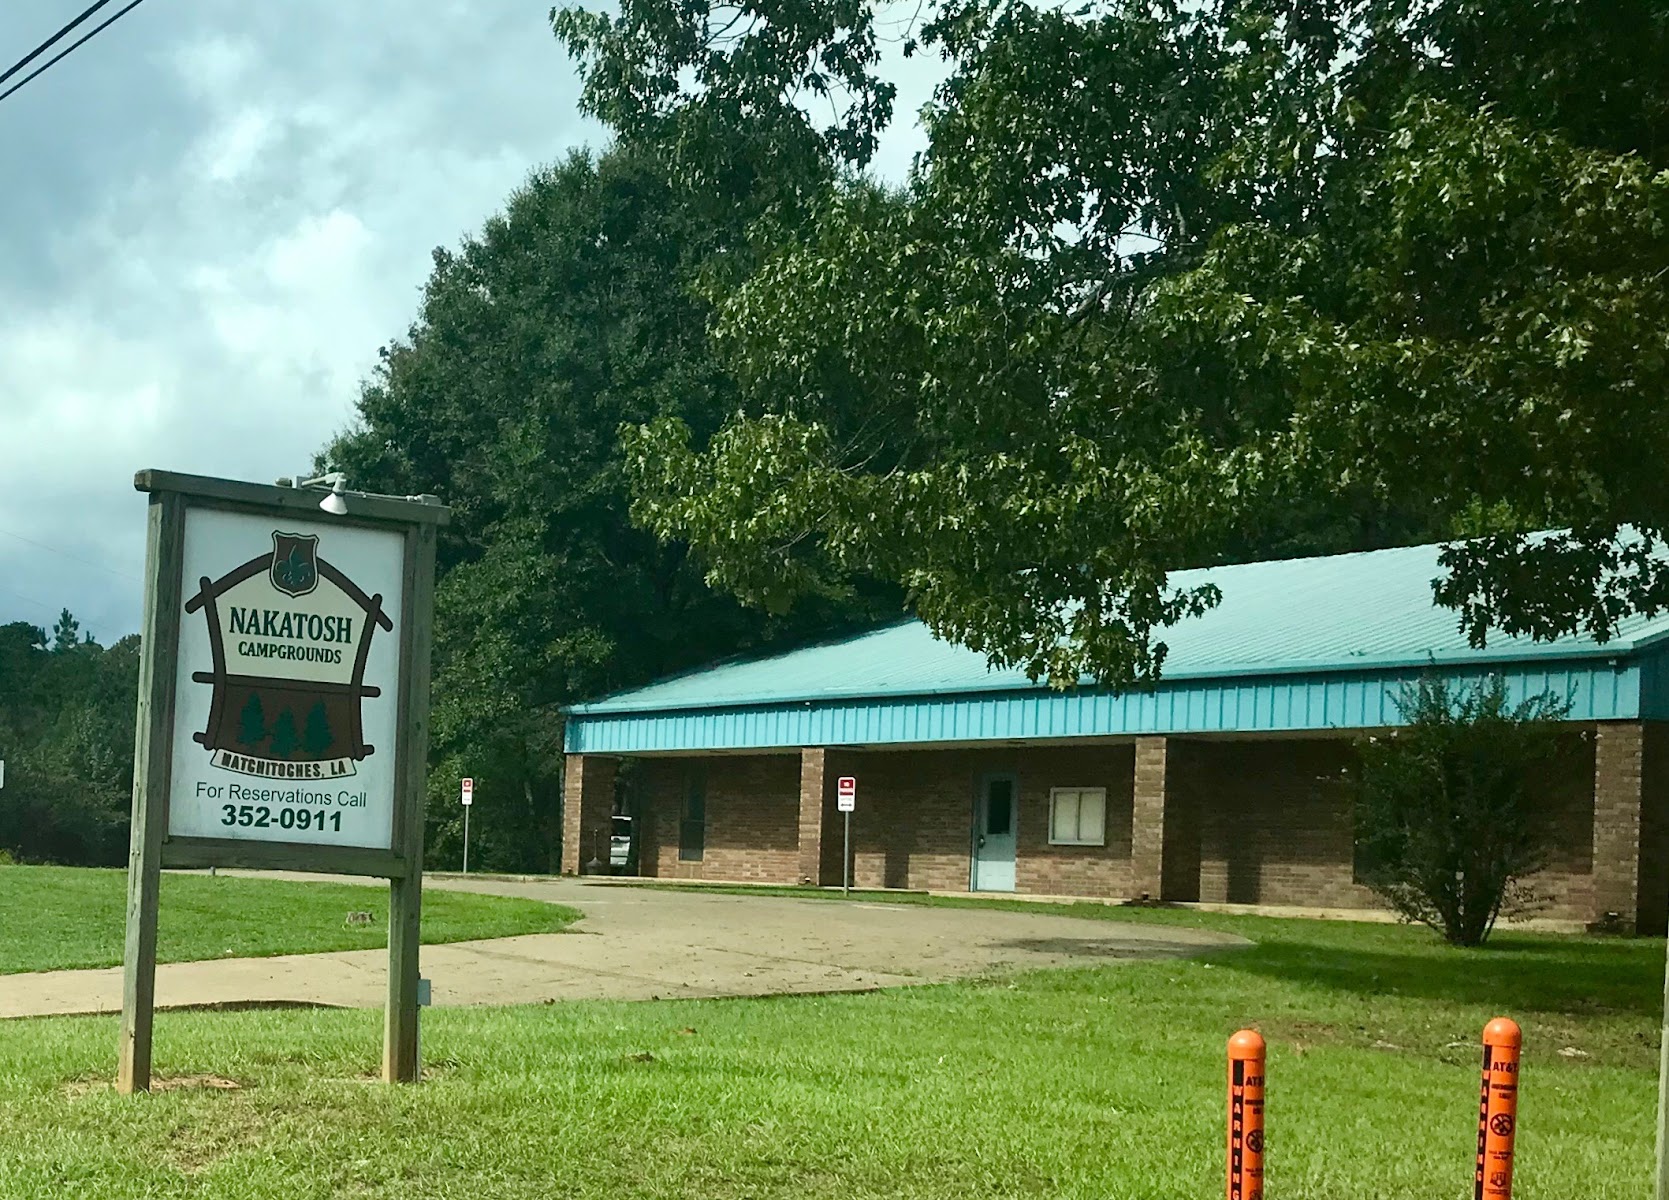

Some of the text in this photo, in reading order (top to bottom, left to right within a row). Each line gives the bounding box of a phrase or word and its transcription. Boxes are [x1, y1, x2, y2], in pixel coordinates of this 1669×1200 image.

[229, 607, 352, 643] NAKATOSH
[238, 641, 342, 664] CAMPGROUNDS
[330, 760, 347, 775] LA
[196, 782, 367, 808] For Reservations Call
[221, 804, 342, 832] 352-0911
[1493, 1061, 1518, 1073] AT&T
[1232, 1085, 1244, 1200] WARNING
